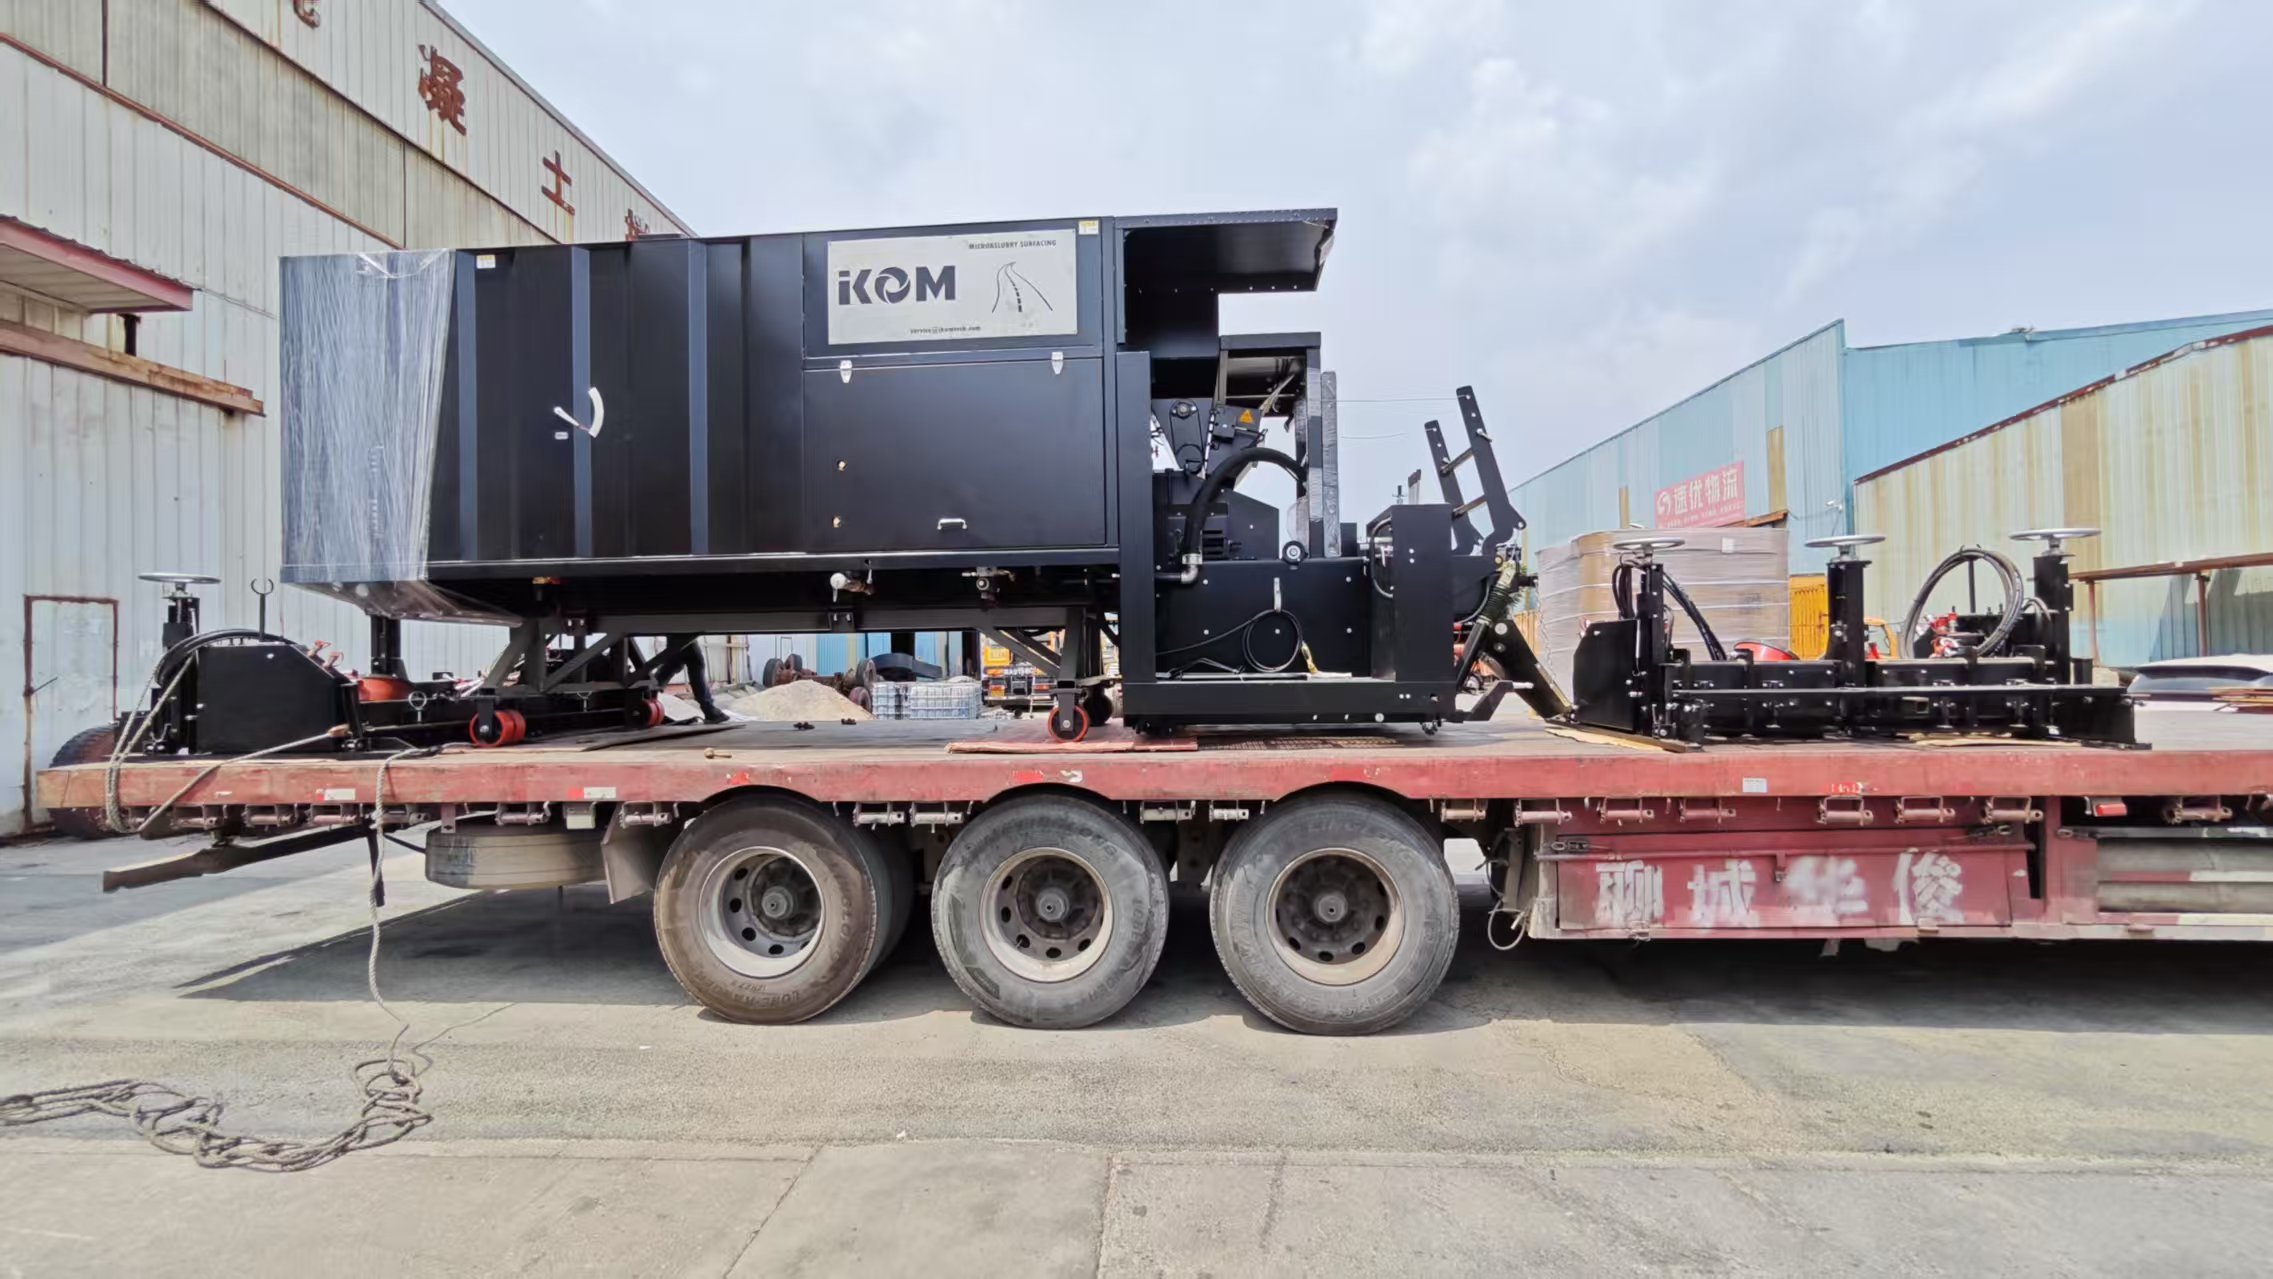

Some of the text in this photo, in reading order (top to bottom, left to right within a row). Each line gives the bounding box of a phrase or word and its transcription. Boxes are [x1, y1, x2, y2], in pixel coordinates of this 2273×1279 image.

[1020, 239, 1057, 249] SURFACING
[1673, 464, 1738, 515] 速优物流
